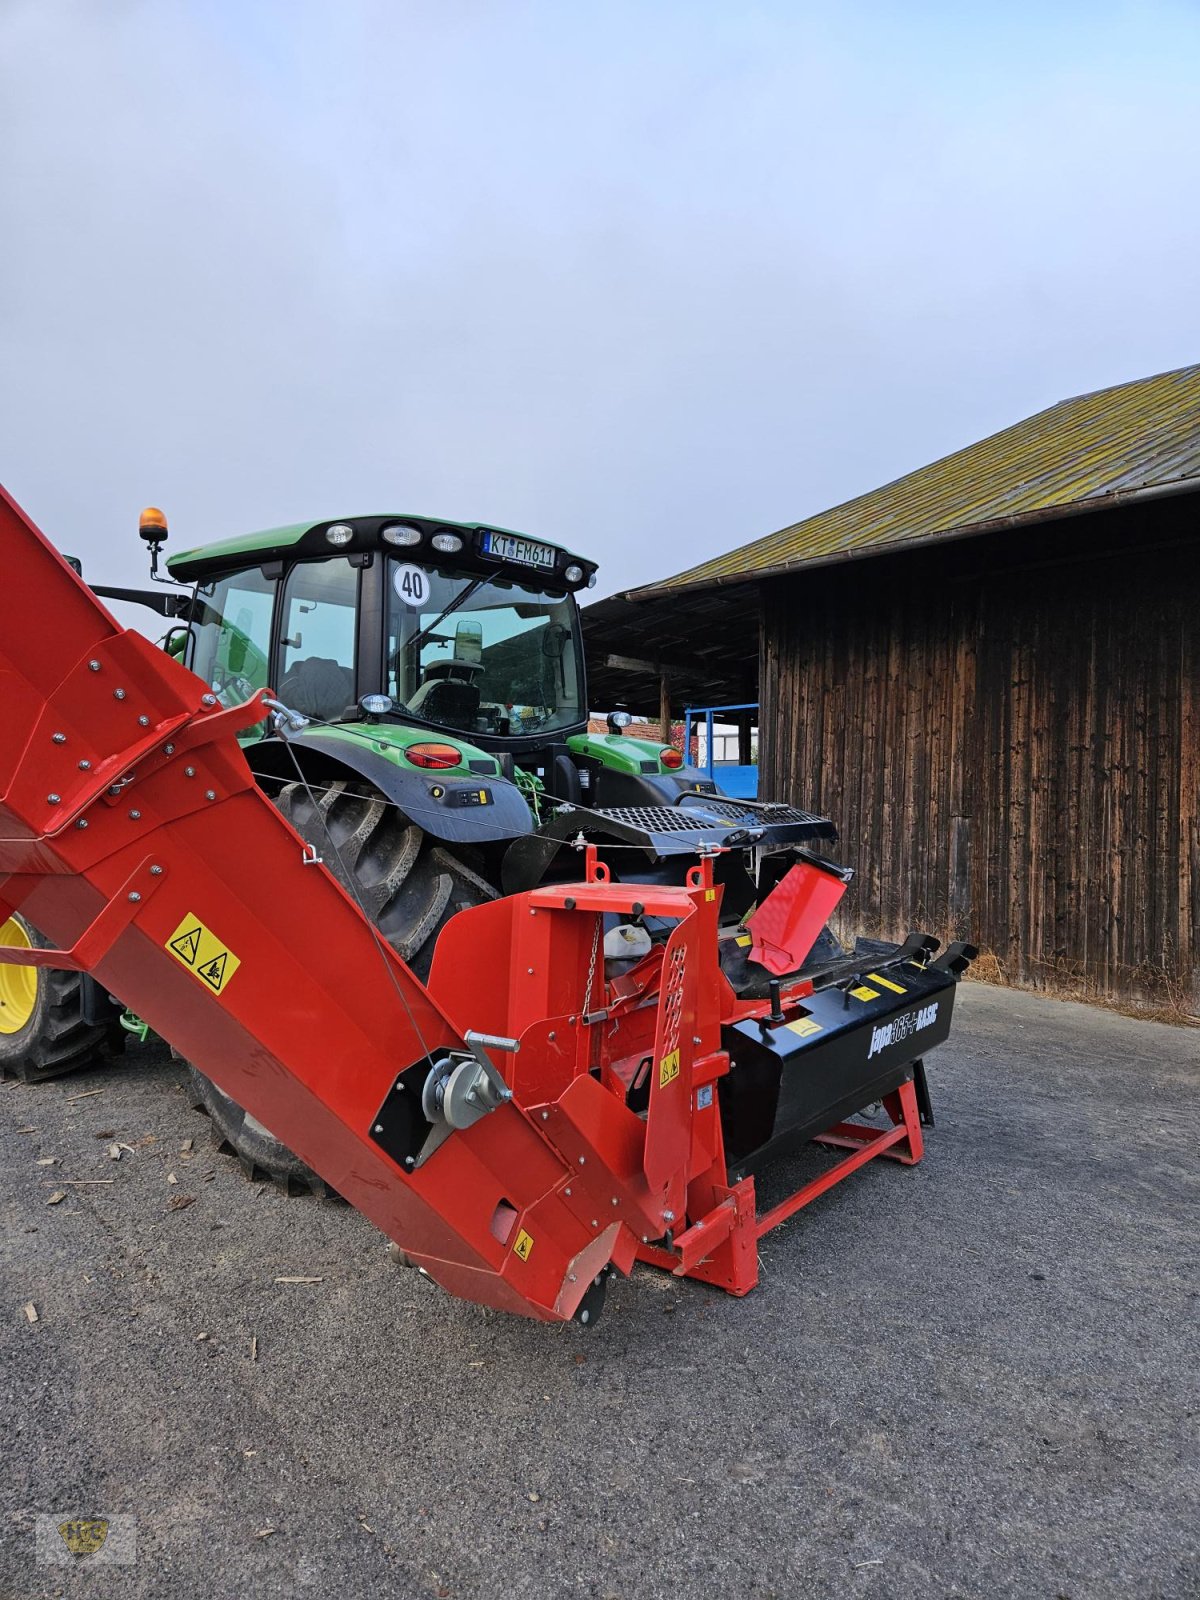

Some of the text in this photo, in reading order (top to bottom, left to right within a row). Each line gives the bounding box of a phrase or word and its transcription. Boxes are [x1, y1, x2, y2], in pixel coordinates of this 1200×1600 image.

[491, 535, 508, 554] KT
[516, 541, 553, 566] FM611
[402, 571, 422, 599] 40
